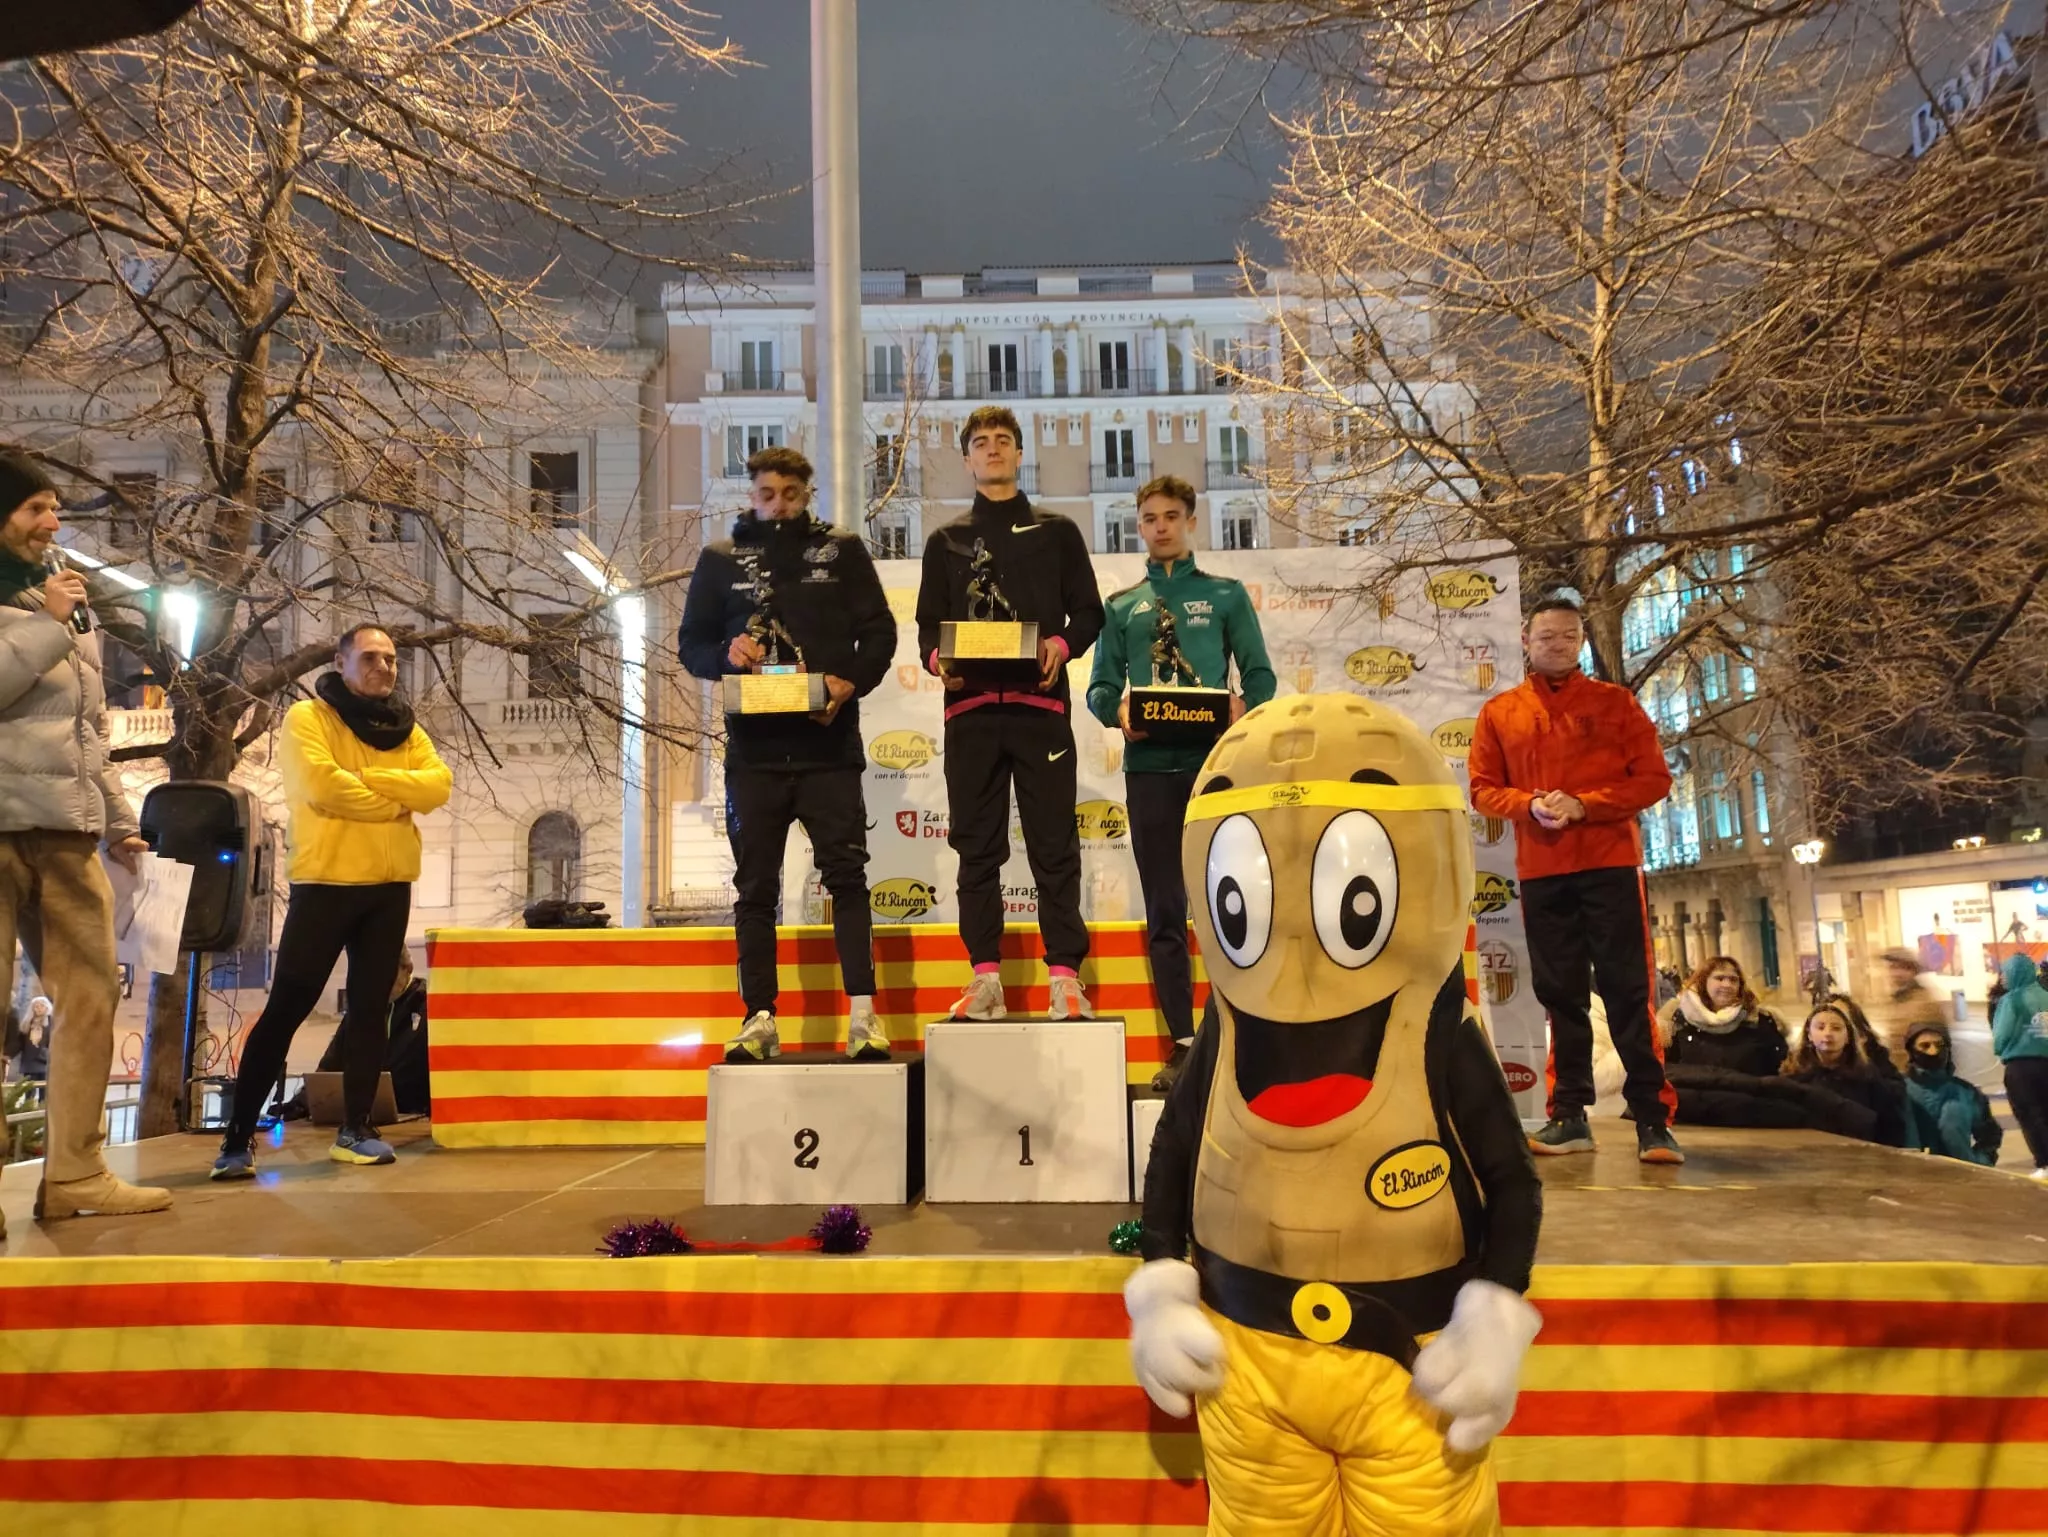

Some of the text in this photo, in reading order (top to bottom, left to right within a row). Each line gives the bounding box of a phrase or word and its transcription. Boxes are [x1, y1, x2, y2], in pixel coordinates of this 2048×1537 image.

[954, 311, 1164, 325] DIPUTACIÓN PROVINCIAL
[1432, 582, 1445, 599] El
[1141, 700, 1216, 722] El Rincón
[1439, 731, 1453, 748] El
[875, 743, 889, 759] El
[874, 772, 888, 780] con
[890, 771, 898, 780] el
[873, 890, 887, 907] El
[794, 1125, 1035, 1170] 2 1
[1379, 1161, 1446, 1197] El Rincón
